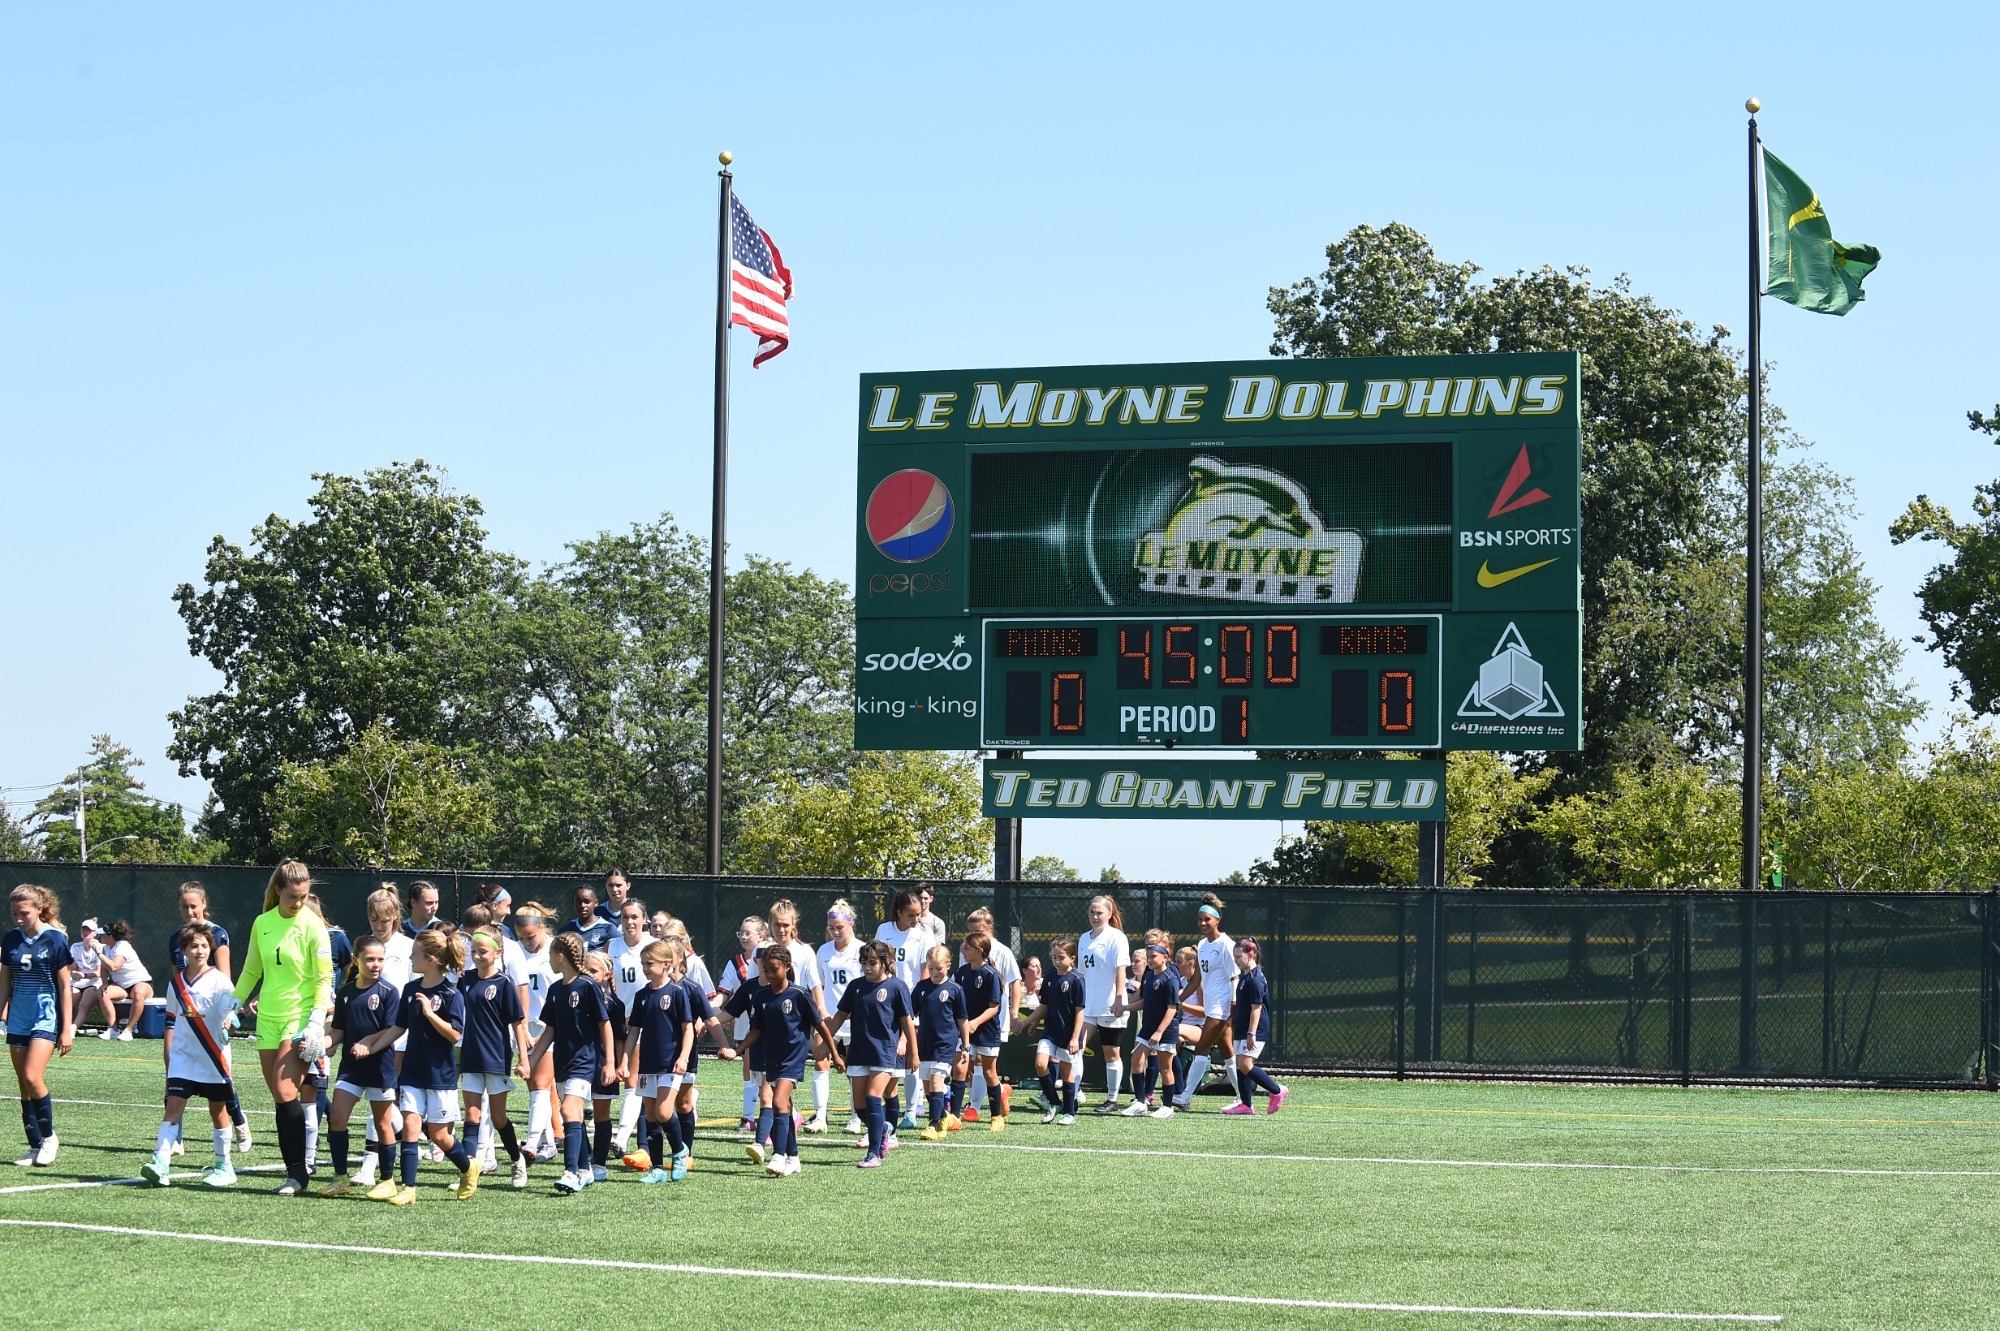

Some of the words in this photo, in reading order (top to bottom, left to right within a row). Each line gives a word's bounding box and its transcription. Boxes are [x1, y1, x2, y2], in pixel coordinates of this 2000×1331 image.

[867, 385, 957, 431] LE
[966, 380, 1208, 428] MOYNE
[1222, 374, 1568, 421] DOLPHINS
[1460, 531, 1502, 547] BSN
[1505, 528, 1571, 546] SPORTS
[869, 568, 949, 598] pepsi
[1008, 629, 1082, 656] PHINS
[1340, 626, 1408, 654] RAMS
[862, 646, 972, 671] sodexo
[857, 696, 905, 718] king
[928, 696, 977, 718] king
[1053, 673, 1083, 730] 0
[1381, 672, 1412, 730] 0
[1120, 705, 1216, 733] PERIOD
[1241, 700, 1247, 738] 1
[989, 770, 1091, 808] TED
[1097, 770, 1277, 808] GRANT
[1281, 771, 1439, 808] FIELD
[20, 953, 32, 971] 5
[275, 947, 282, 966] 1
[1083, 954, 1095, 969] 24
[528, 973, 539, 991] 7
[621, 966, 636, 983] 10
[832, 969, 847, 985] 16
